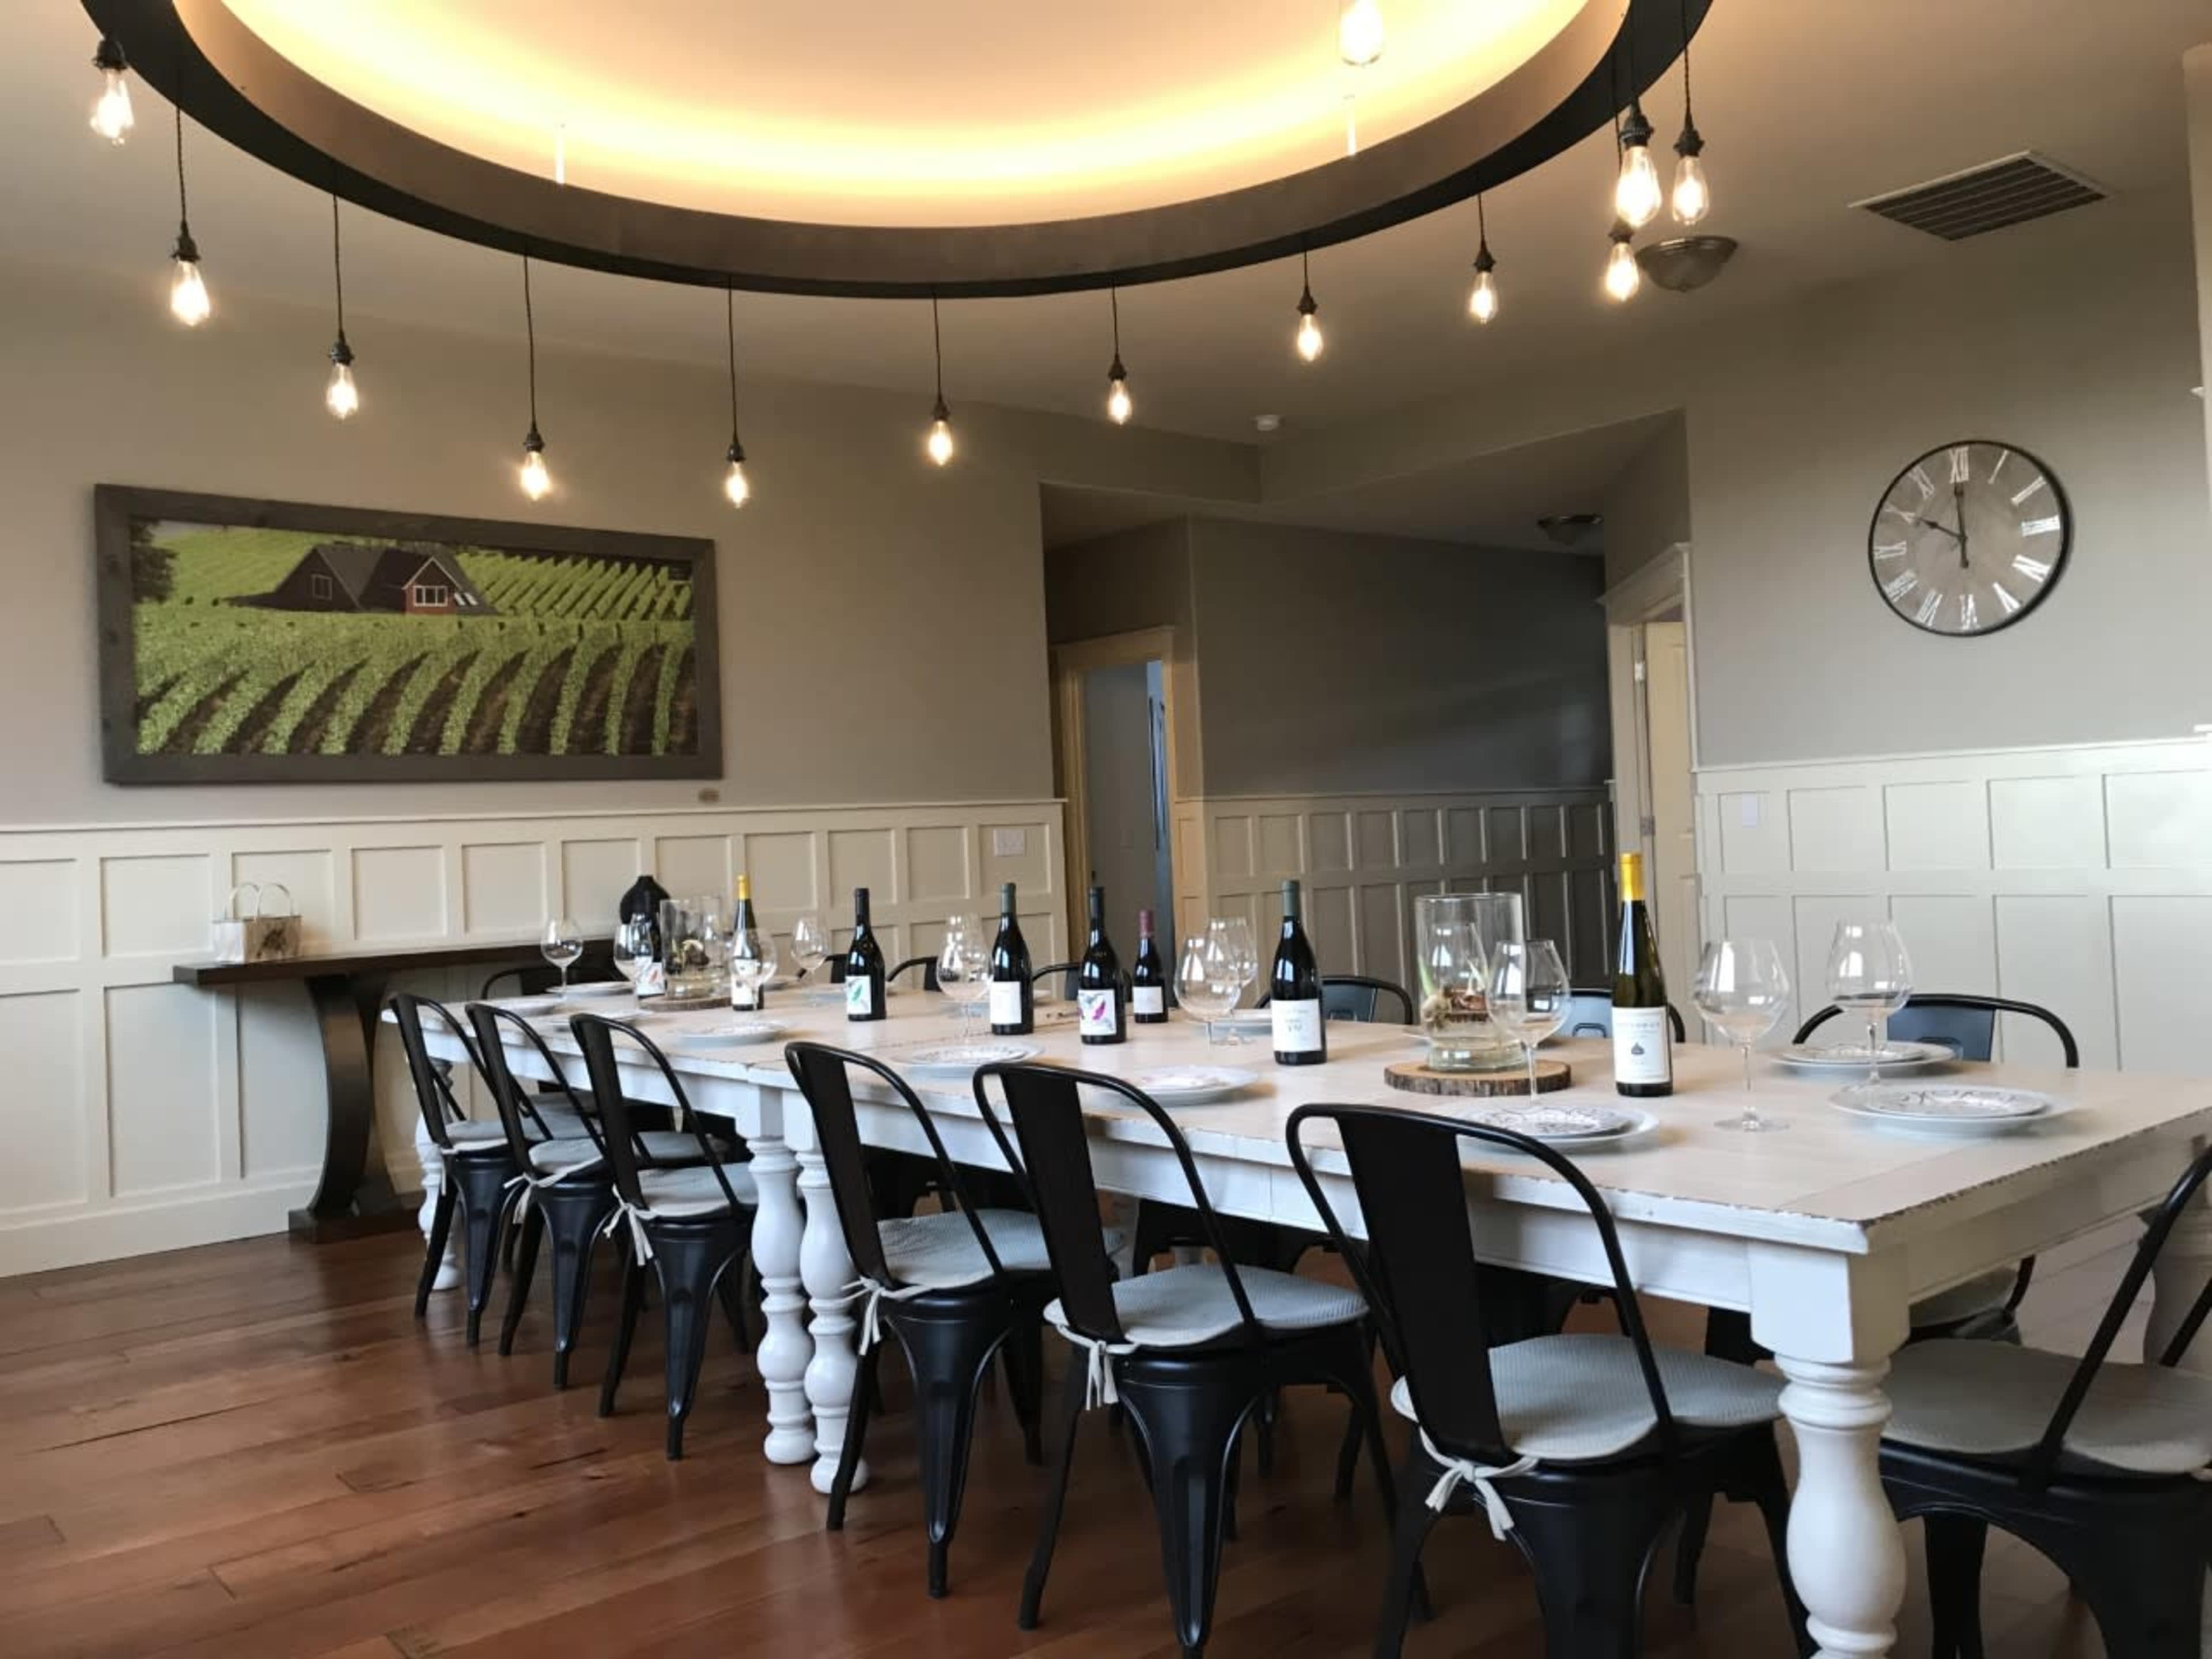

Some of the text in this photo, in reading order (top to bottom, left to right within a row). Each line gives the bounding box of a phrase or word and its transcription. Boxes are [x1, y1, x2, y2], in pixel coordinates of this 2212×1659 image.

[1949, 446, 1969, 484] XII
[2011, 475, 2047, 506] II
[1992, 581, 2021, 613] V
